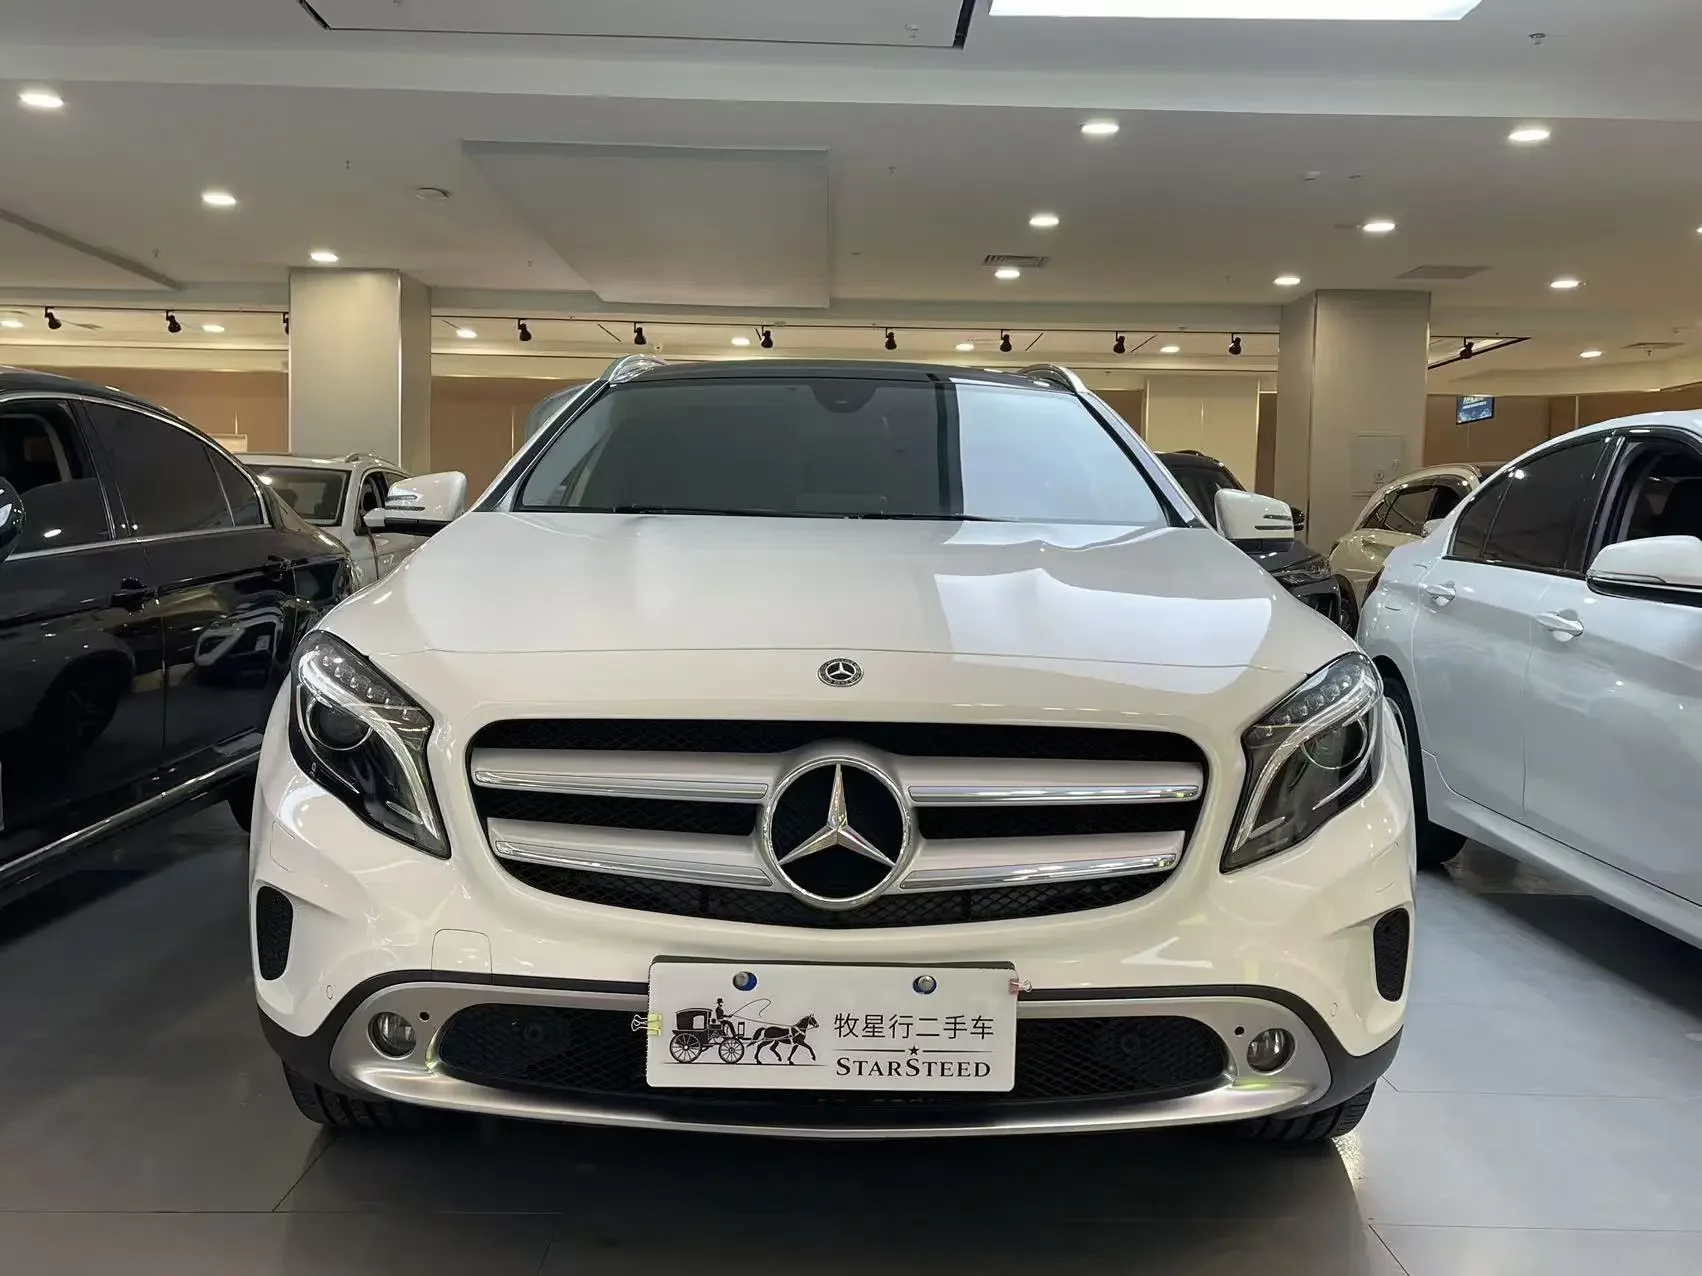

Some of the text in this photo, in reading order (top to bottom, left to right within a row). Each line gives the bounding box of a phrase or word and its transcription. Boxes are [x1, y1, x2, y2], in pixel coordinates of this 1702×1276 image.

[834, 1013, 994, 1040] 牧星行二手车
[836, 1057, 991, 1077] STARSTEED
